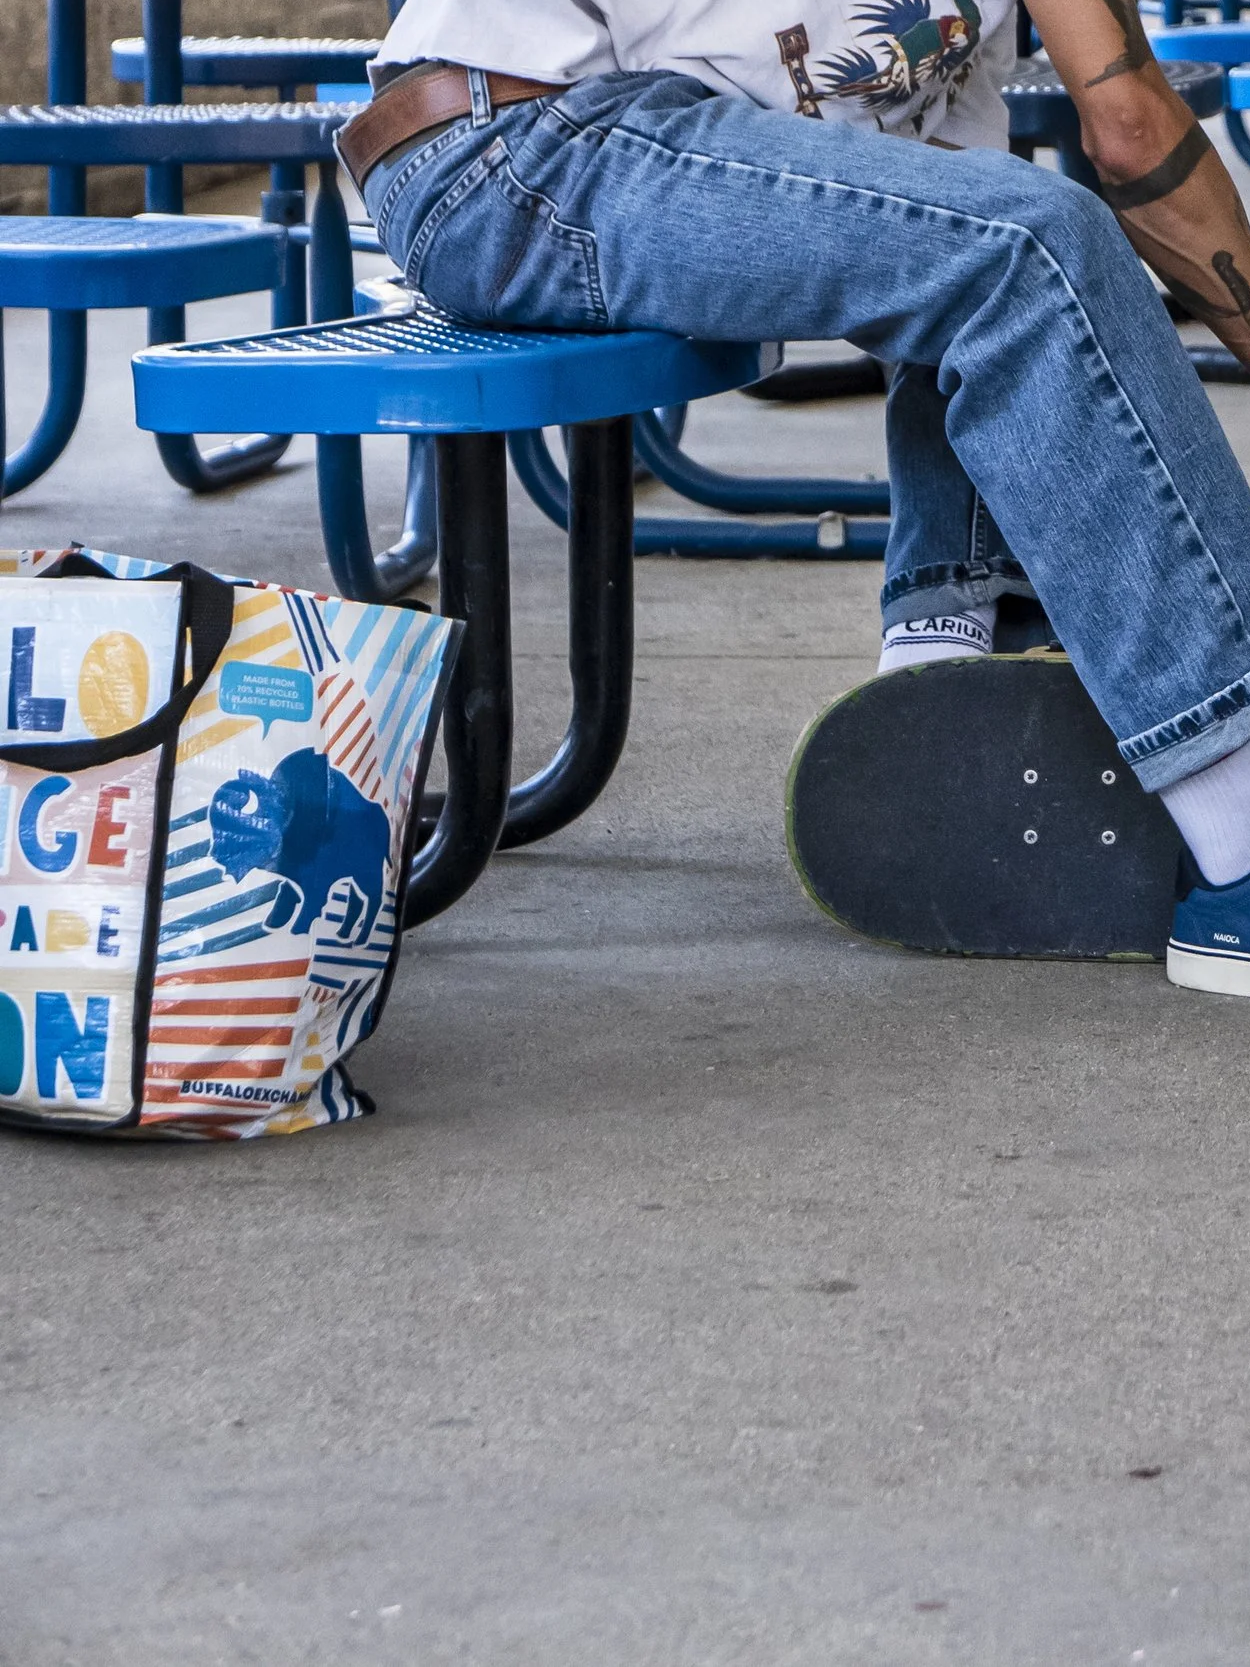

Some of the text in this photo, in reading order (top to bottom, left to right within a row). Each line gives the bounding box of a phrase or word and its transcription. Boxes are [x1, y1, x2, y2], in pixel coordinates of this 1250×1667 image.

[8, 627, 149, 739] LO
[243, 675, 296, 687] MADE FROM
[237, 685, 299, 699] 70% RECYCLED
[231, 695, 305, 710] PLASTIC BOTTLES
[0, 775, 130, 872] GE
[0, 905, 119, 957] ADE
[1213, 932, 1240, 944] NAIOCA
